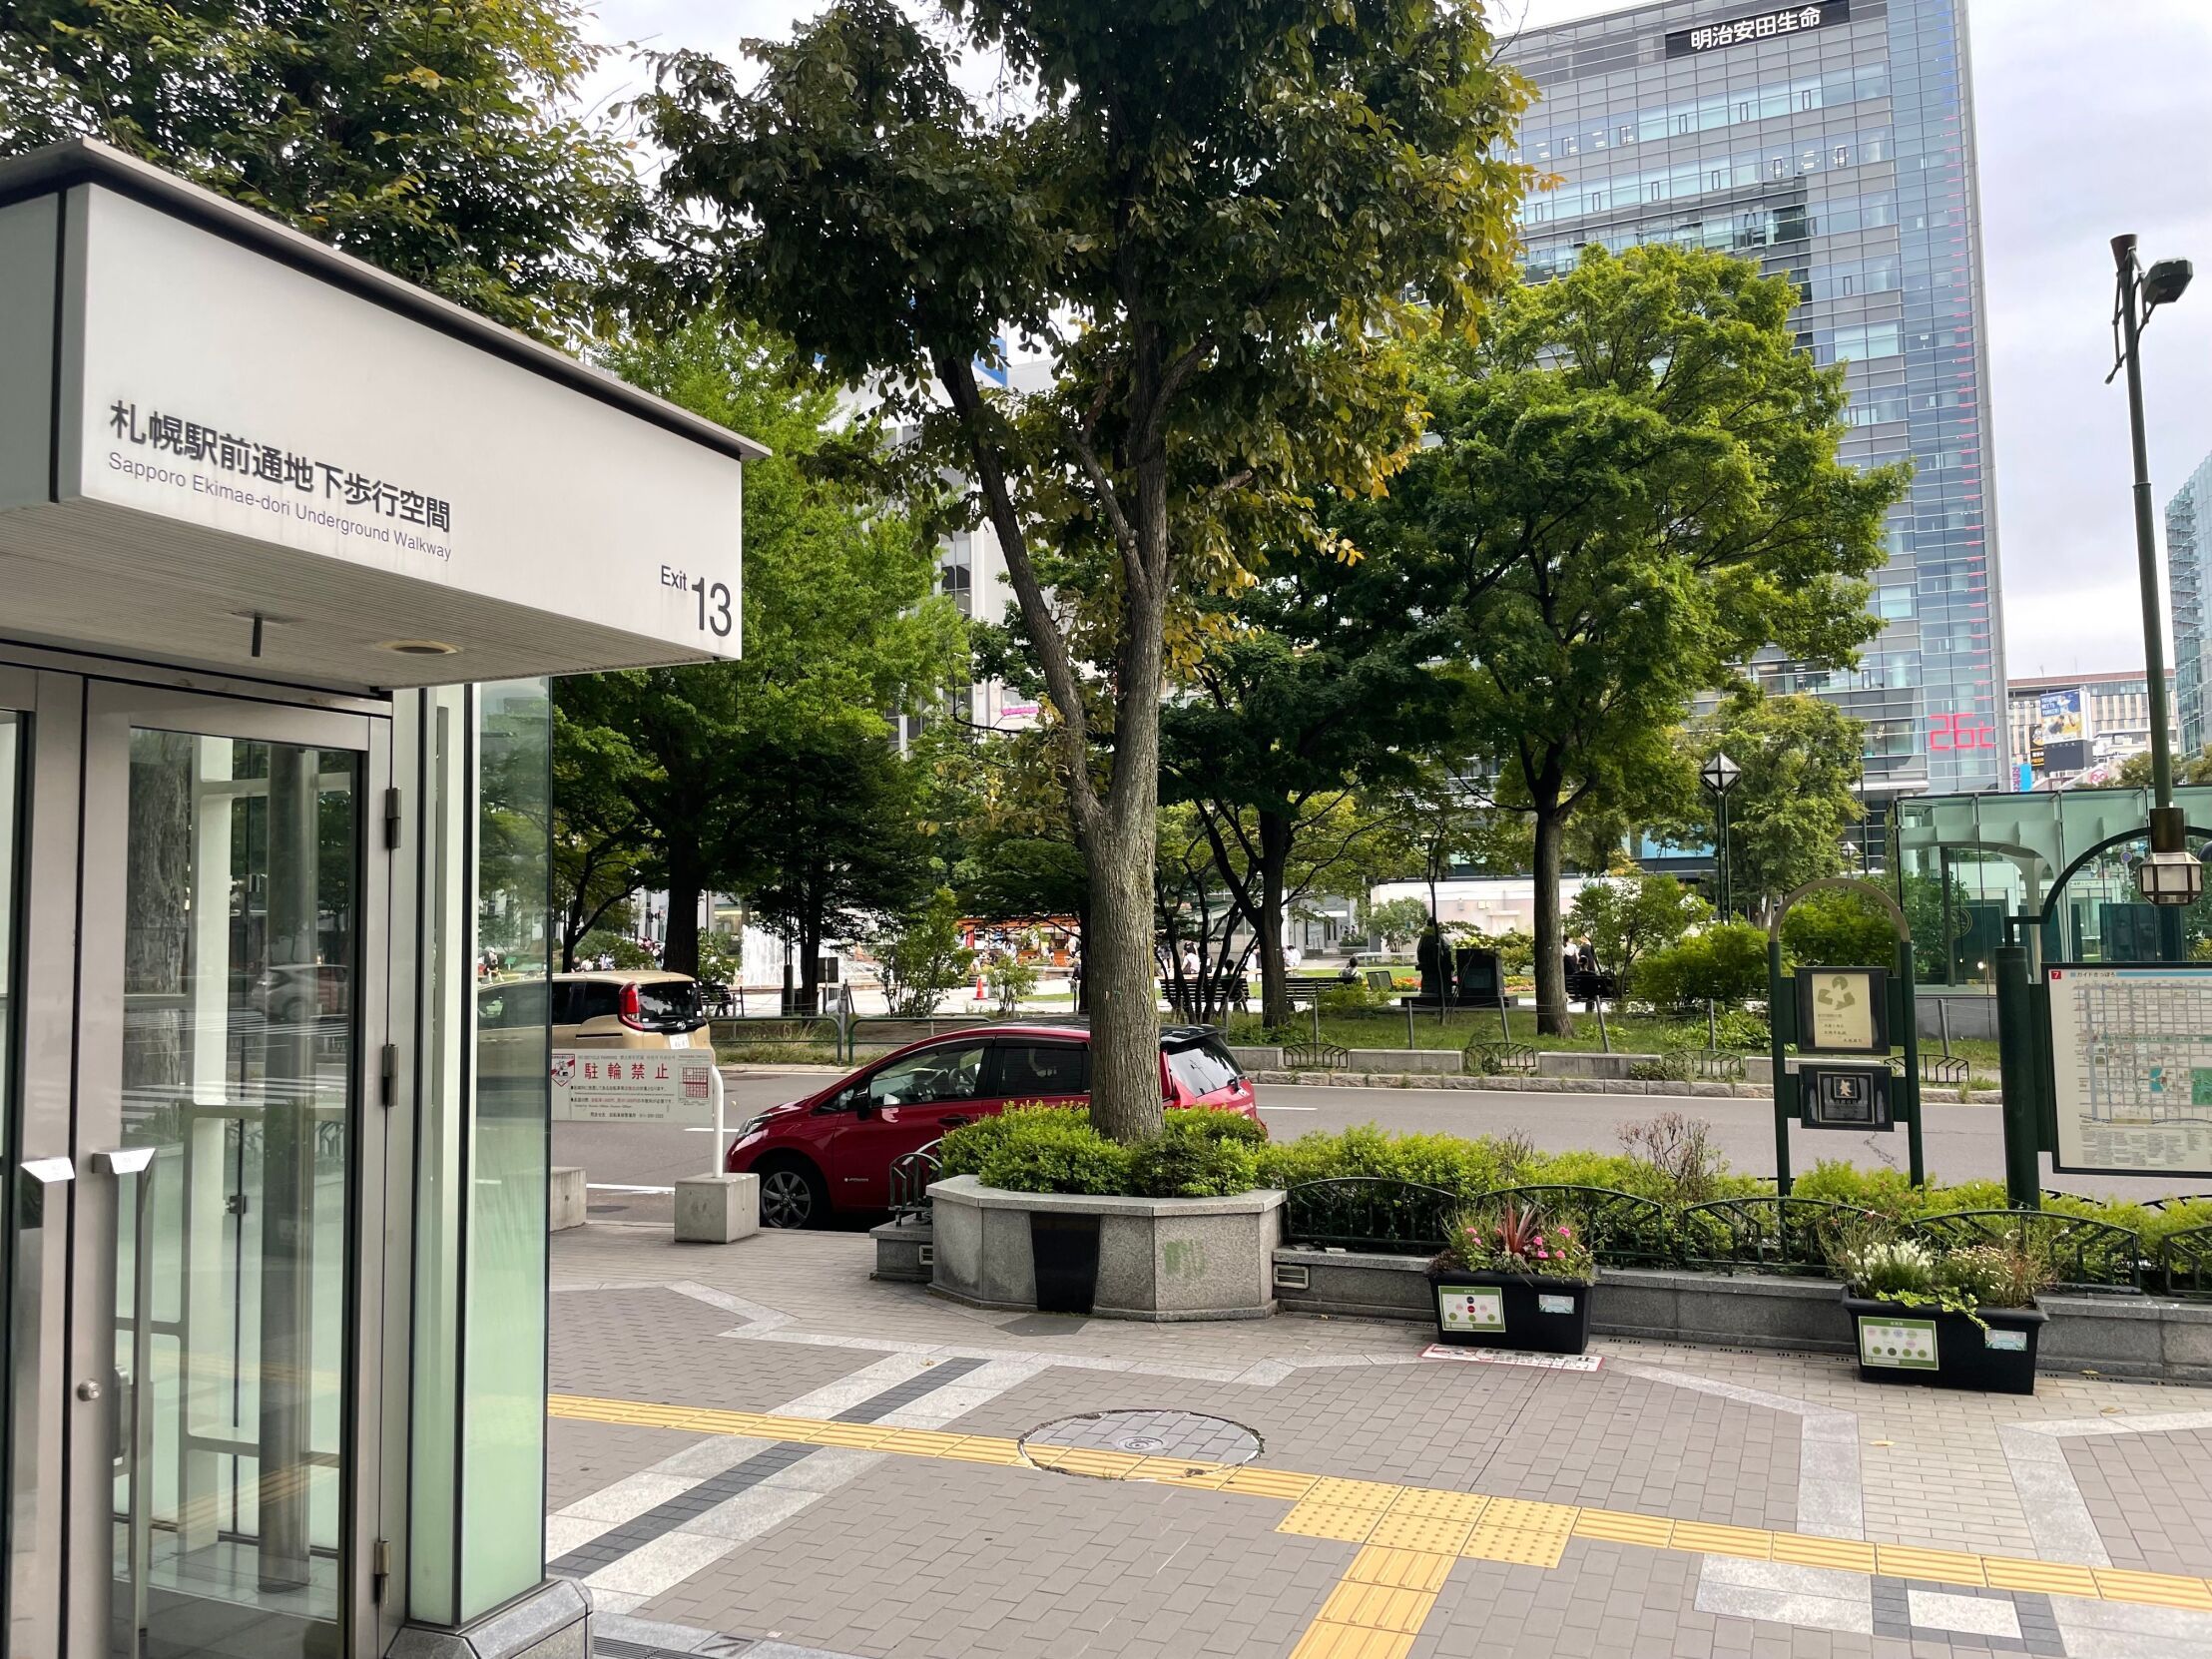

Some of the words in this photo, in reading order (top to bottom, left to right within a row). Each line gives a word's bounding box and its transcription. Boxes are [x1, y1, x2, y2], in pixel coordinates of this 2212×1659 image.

[1690, 6, 1822, 50] 明治安田生命
[110, 399, 450, 533] 札幌駅前通地下歩行空間
[109, 451, 187, 487] Sapporo
[193, 474, 290, 516] Ekimae-dori
[295, 502, 390, 542] Underground
[393, 529, 452, 562] Walkway
[661, 564, 688, 592] Exit
[691, 576, 733, 638] 13
[584, 1062, 670, 1080] 駐輪禁止
